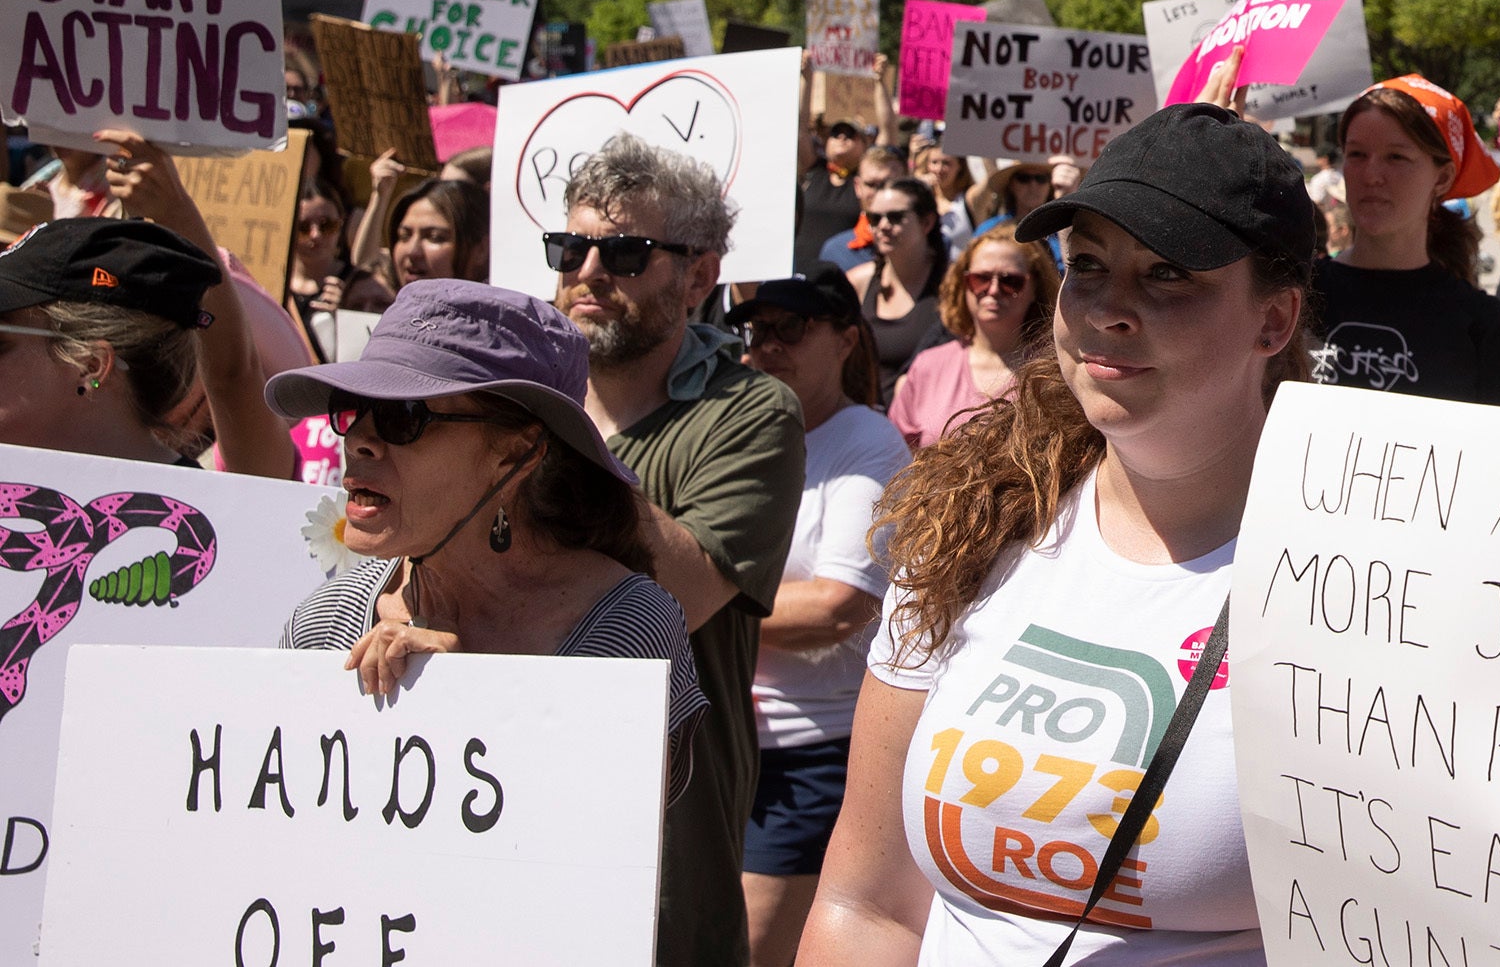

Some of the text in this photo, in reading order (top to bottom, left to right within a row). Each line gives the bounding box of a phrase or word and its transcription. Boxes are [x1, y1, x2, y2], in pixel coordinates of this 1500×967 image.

[11, 10, 276, 138] ACTING
[961, 29, 1149, 73] NOT YOUR
[1024, 68, 1079, 91] BODY
[961, 94, 1134, 124] NOT YOUR
[1002, 122, 1110, 159] CHOICE
[235, 161, 288, 207] AND
[1302, 432, 1463, 530] WHEN
[1262, 548, 1432, 648] MORE
[965, 673, 1107, 743] PRO
[1274, 662, 1457, 780] THAN
[924, 727, 1165, 846] 1973
[1281, 774, 1401, 874] IT'S
[992, 826, 1148, 907] ROE
[1288, 879, 1325, 951] A
